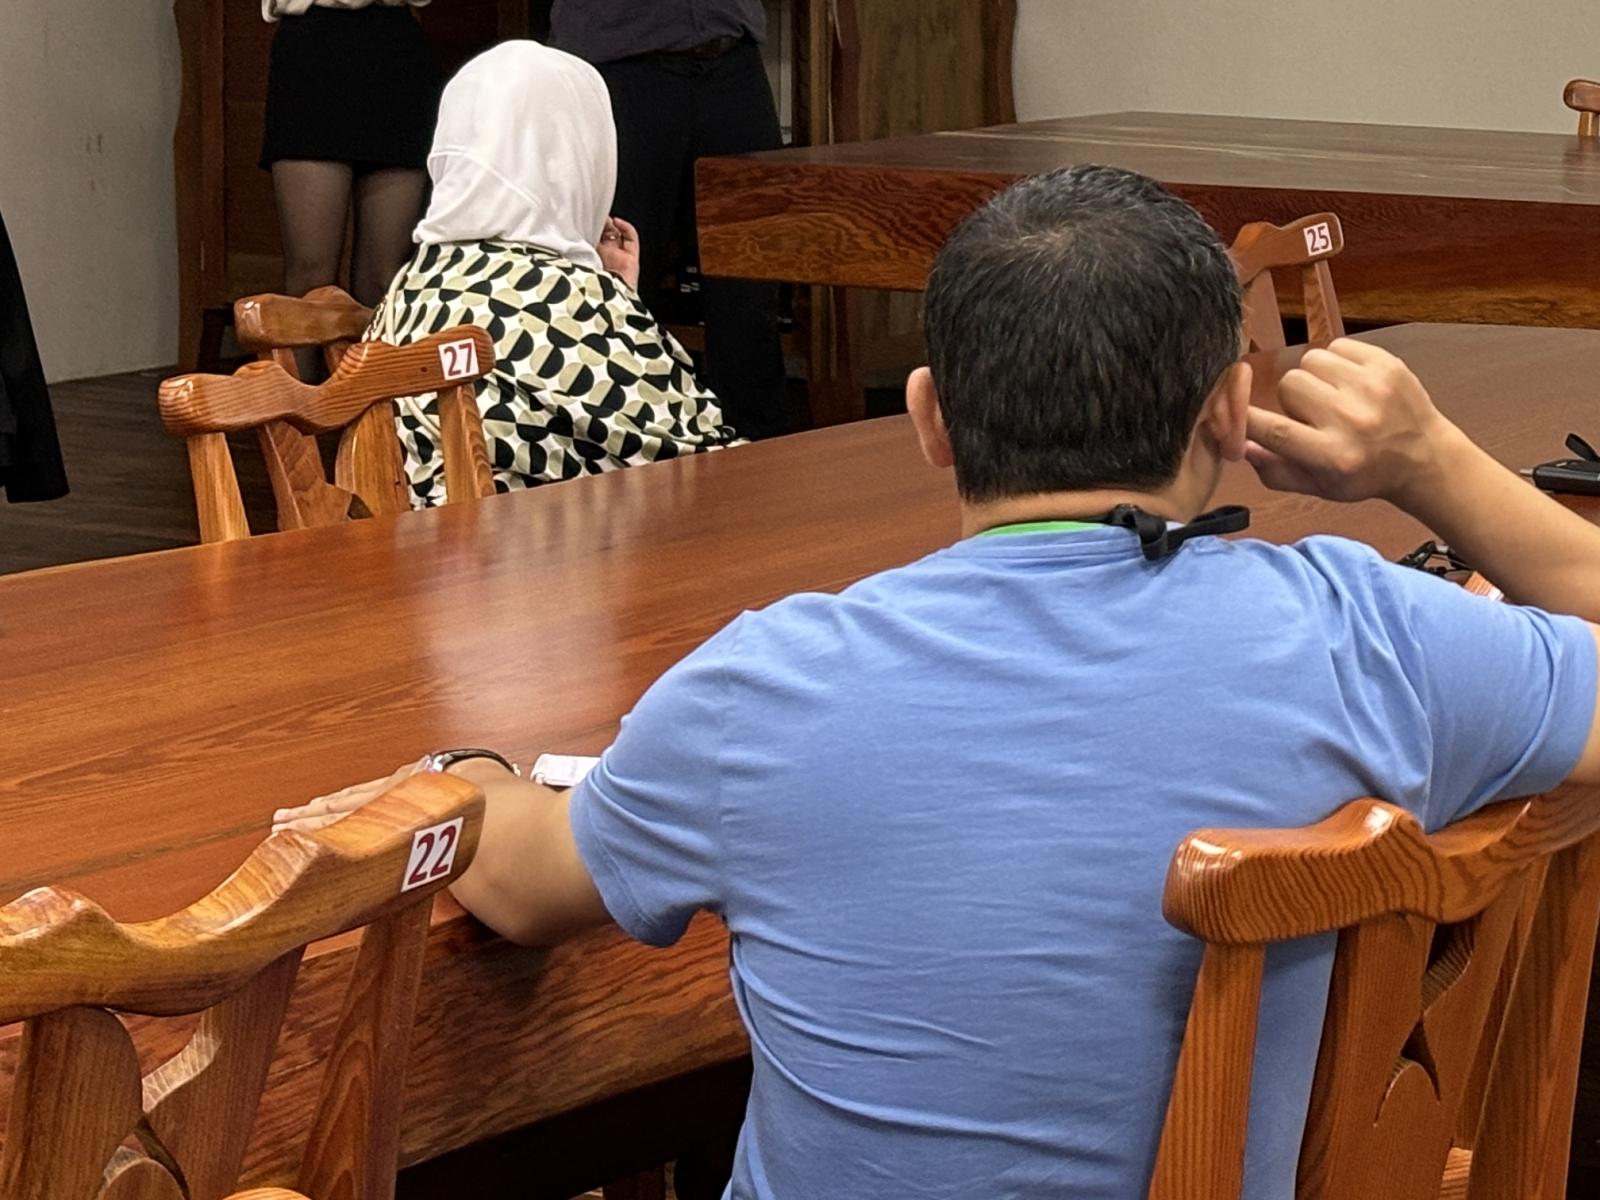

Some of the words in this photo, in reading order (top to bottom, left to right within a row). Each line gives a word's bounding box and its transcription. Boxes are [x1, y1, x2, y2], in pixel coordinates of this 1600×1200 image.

[1307, 225, 1329, 252] 25
[444, 343, 472, 376] 27
[408, 825, 456, 885] 22
